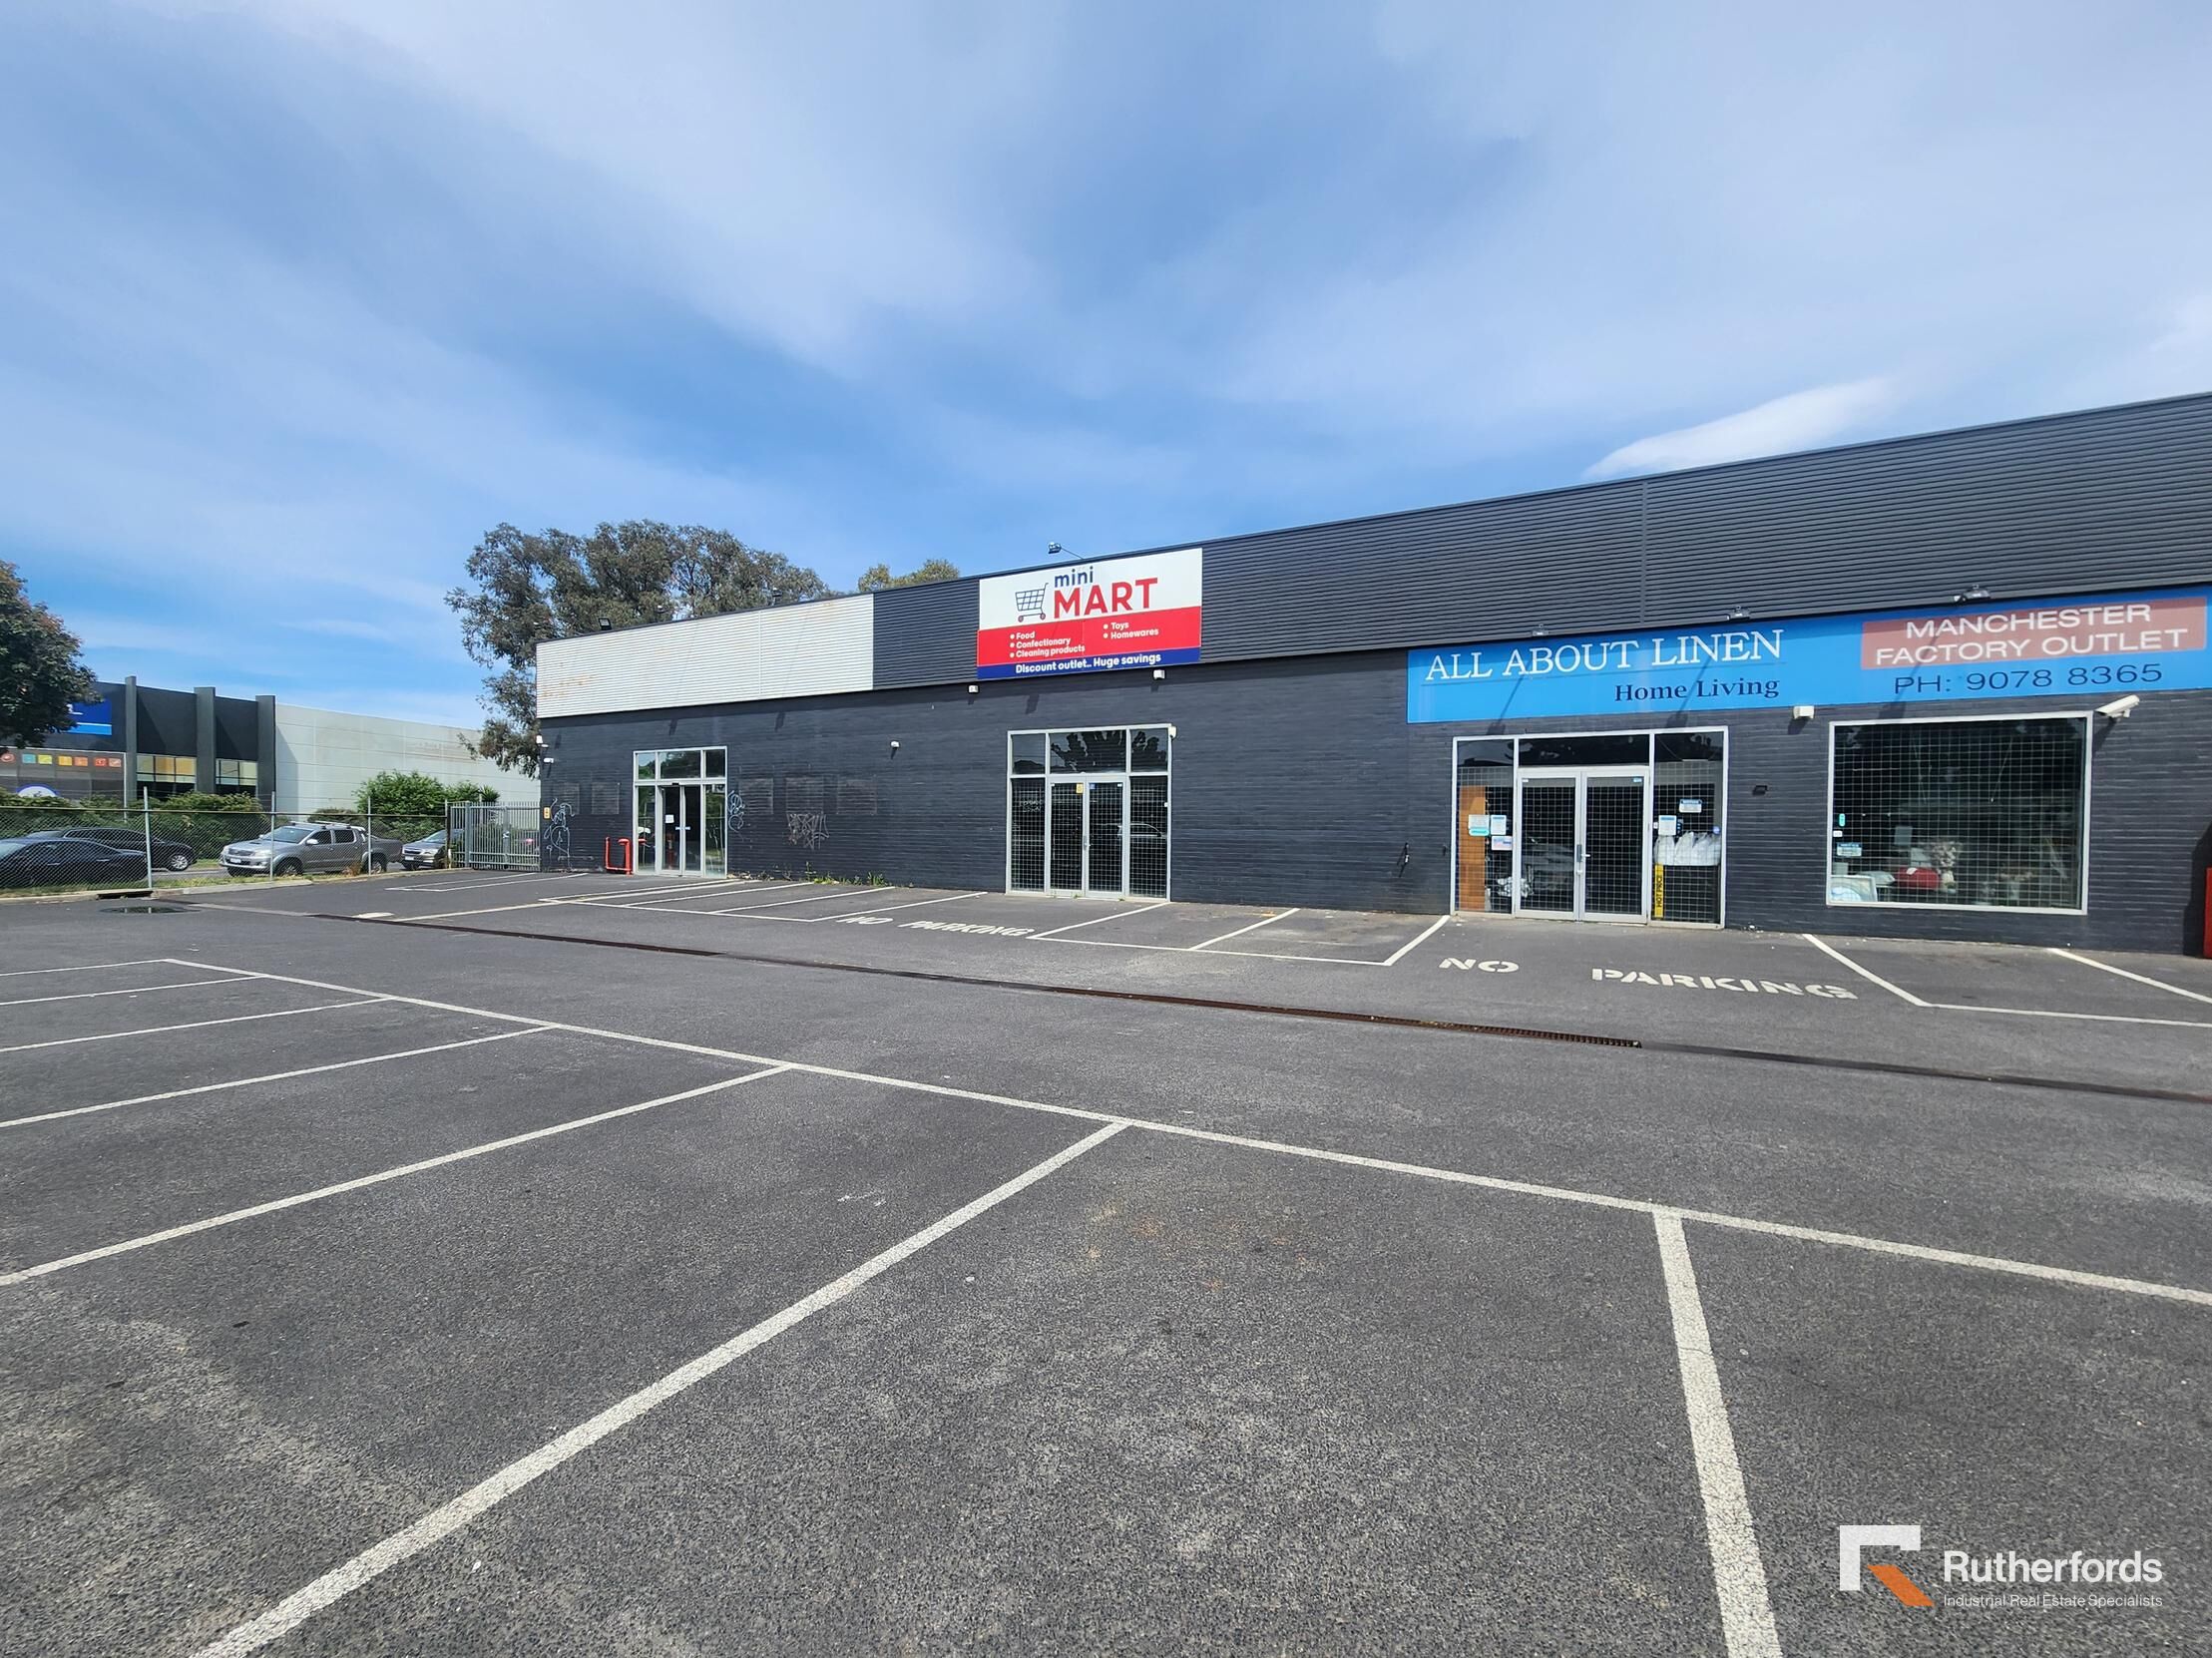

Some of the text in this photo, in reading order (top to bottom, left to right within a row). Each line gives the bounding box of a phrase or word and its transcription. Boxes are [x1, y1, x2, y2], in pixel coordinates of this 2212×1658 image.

[1054, 566, 1095, 588] mini
[1054, 577, 1158, 620] MART
[1110, 622, 1129, 631] Toys
[1906, 604, 2152, 639] MANCHESTER
[1016, 630, 1036, 639] Food
[1016, 637, 1072, 649] Confectionary
[1110, 628, 1159, 639] Homewares
[1016, 644, 1086, 659] Cleaning products
[1425, 628, 1785, 681] ALL ABOUT LINEN
[1876, 628, 2189, 665] FACTORY OUTLET
[1015, 661, 1057, 674] Discount
[1094, 656, 1119, 669] Huge
[1120, 652, 1161, 667] savings
[1614, 676, 1780, 702] Home Living
[1895, 662, 2163, 694] PH: 9078 8365
[835, 916, 1036, 937] NO PARKING
[1438, 957, 1859, 1001] NO PARKING
